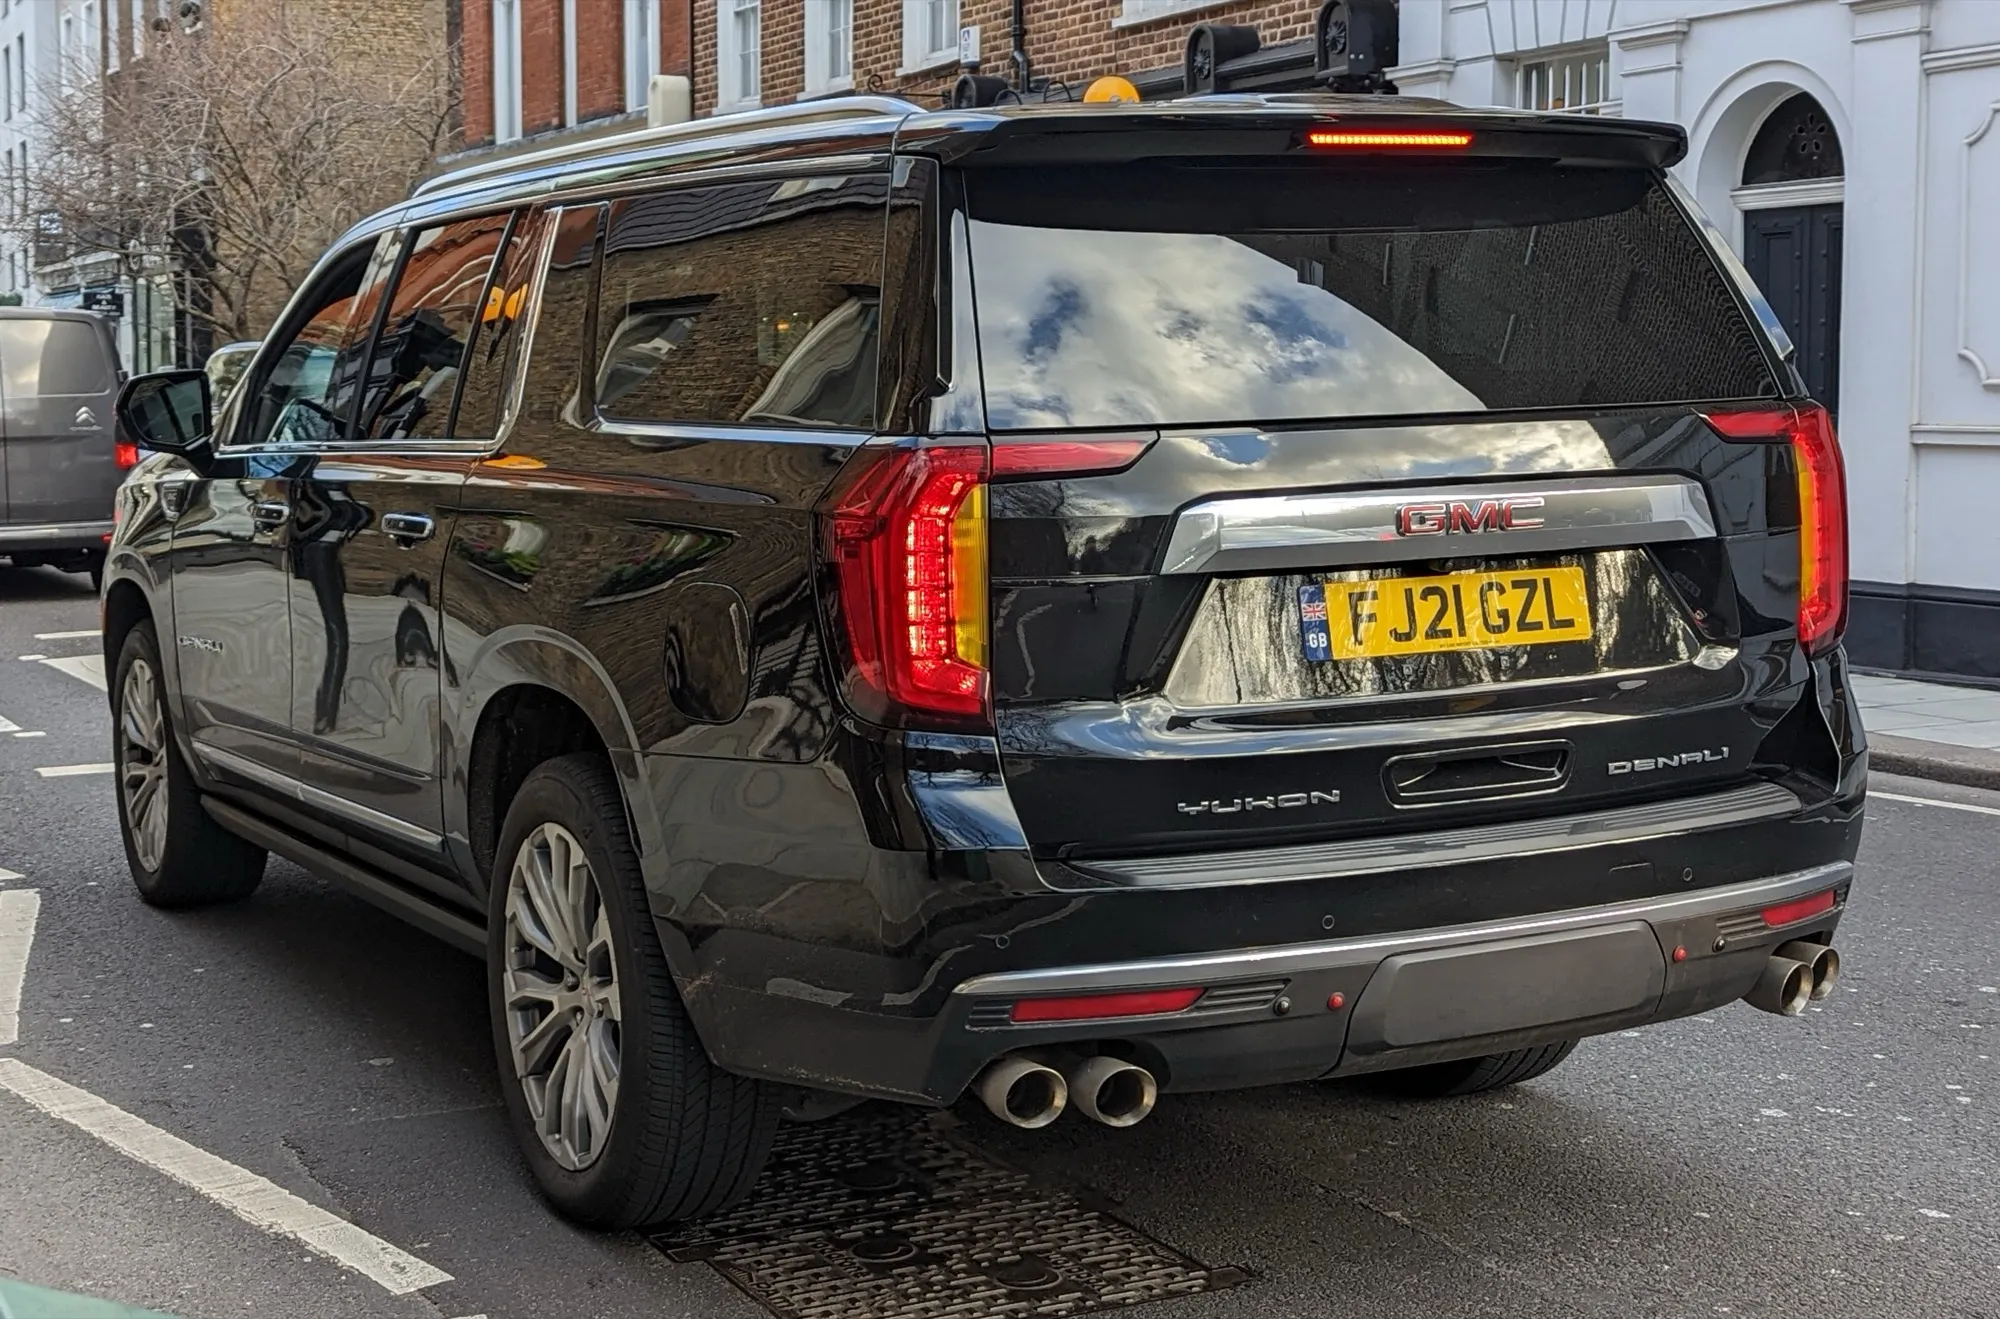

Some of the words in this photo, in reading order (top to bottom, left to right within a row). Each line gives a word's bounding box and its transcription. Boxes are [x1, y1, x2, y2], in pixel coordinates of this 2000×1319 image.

[1395, 497, 1545, 537] GMC
[1348, 584, 1467, 646] FJ21
[1479, 577, 1576, 635] GZL
[1308, 632, 1328, 649] GB
[1607, 746, 1730, 776] DENALI
[1177, 789, 1341, 816] YUKON
